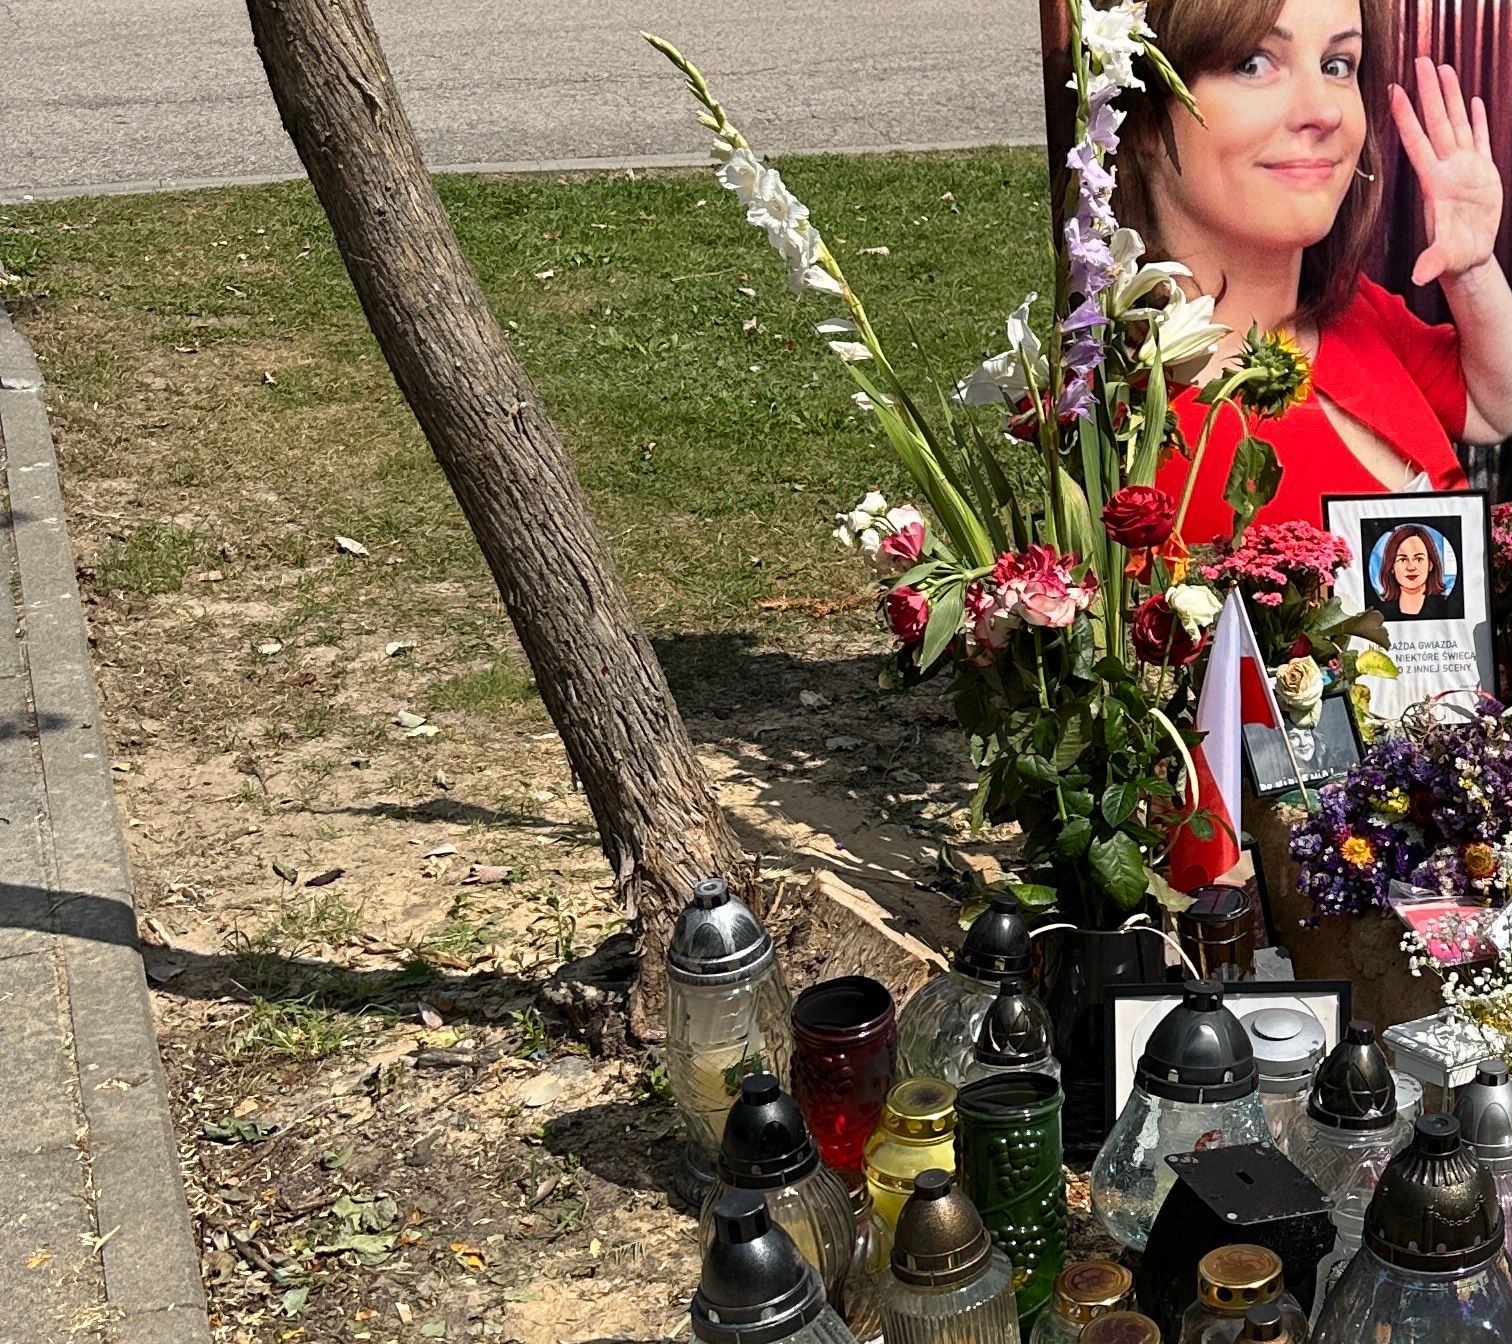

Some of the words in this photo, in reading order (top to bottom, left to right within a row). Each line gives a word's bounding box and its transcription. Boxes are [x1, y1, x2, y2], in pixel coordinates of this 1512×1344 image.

[1390, 640, 1415, 651] AŻDA
[1418, 640, 1457, 650] GWIAZDA
[1396, 652, 1440, 662] NIEKTÓRE
[1406, 665, 1412, 674] Z
[1414, 664, 1440, 674] INNEJ
